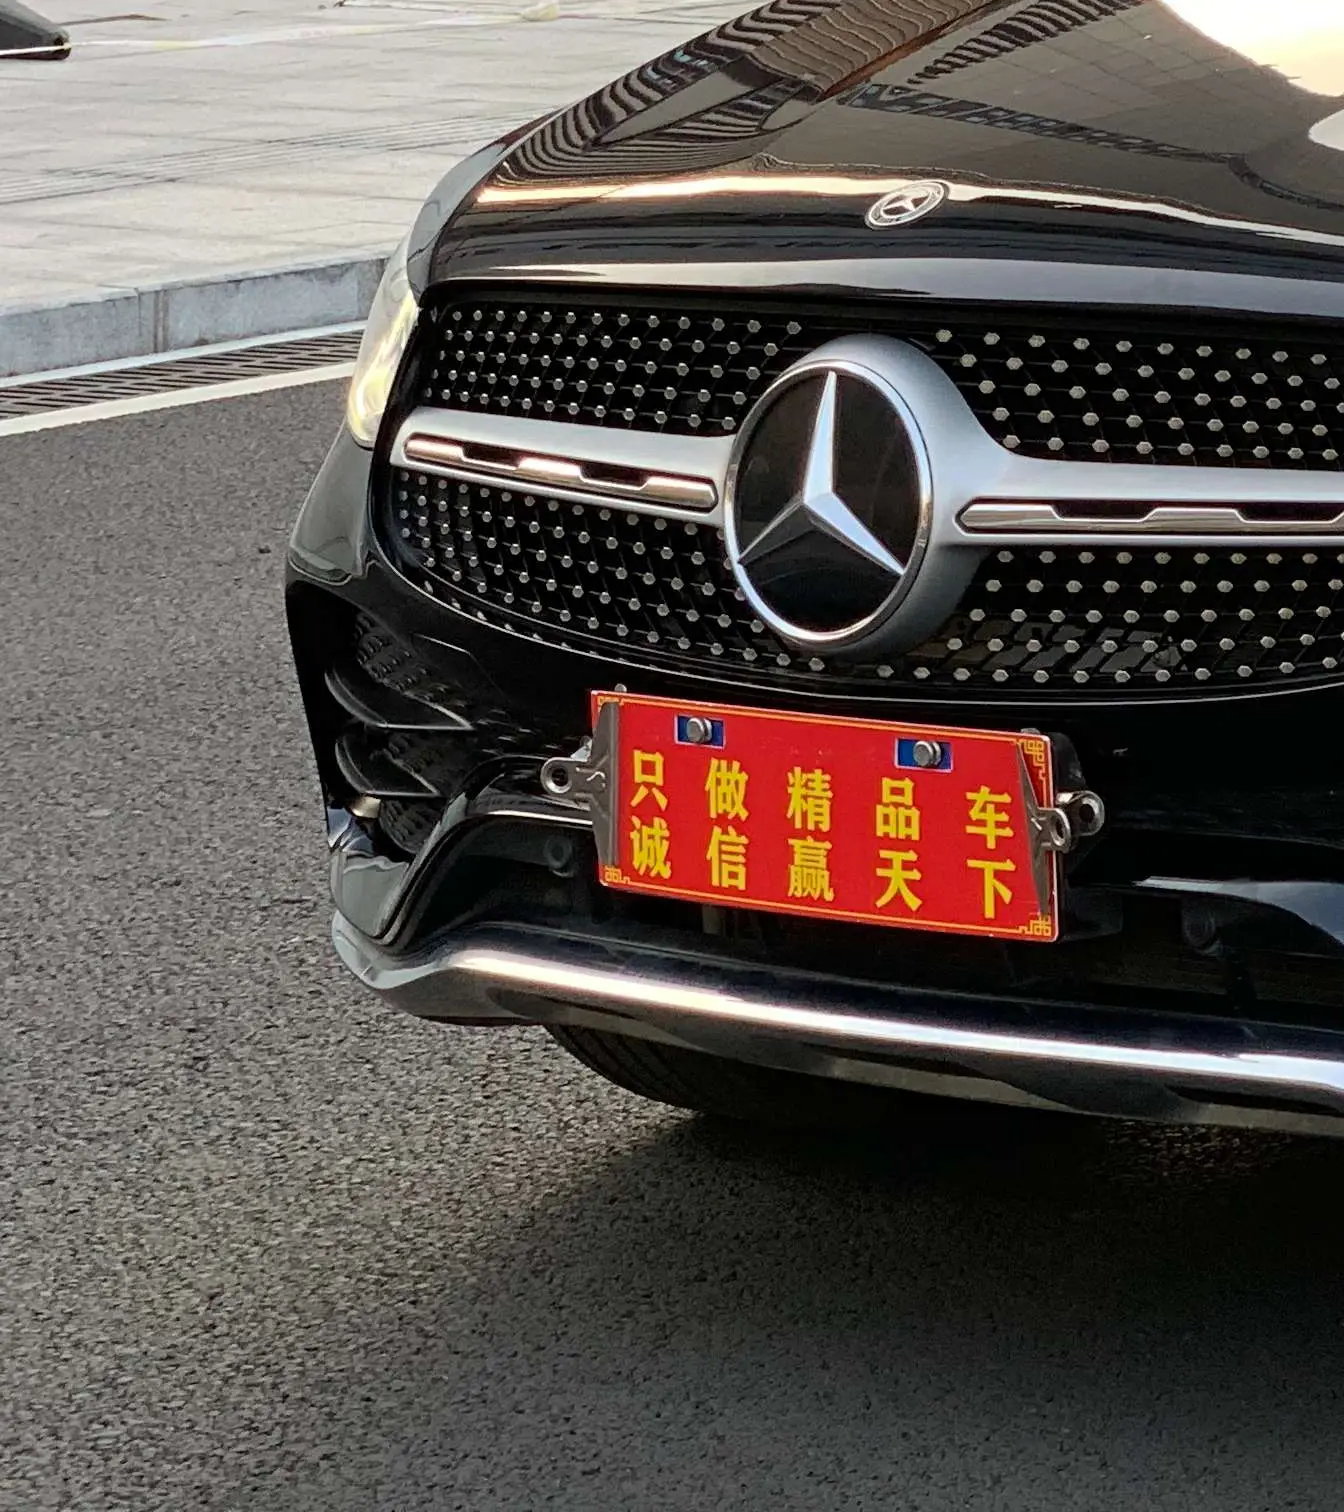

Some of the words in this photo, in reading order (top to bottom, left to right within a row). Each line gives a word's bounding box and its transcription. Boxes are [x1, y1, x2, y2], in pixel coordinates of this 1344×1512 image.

[630, 749, 1014, 850] 只做精品车
[629, 816, 1015, 919] 诚信赢天下
